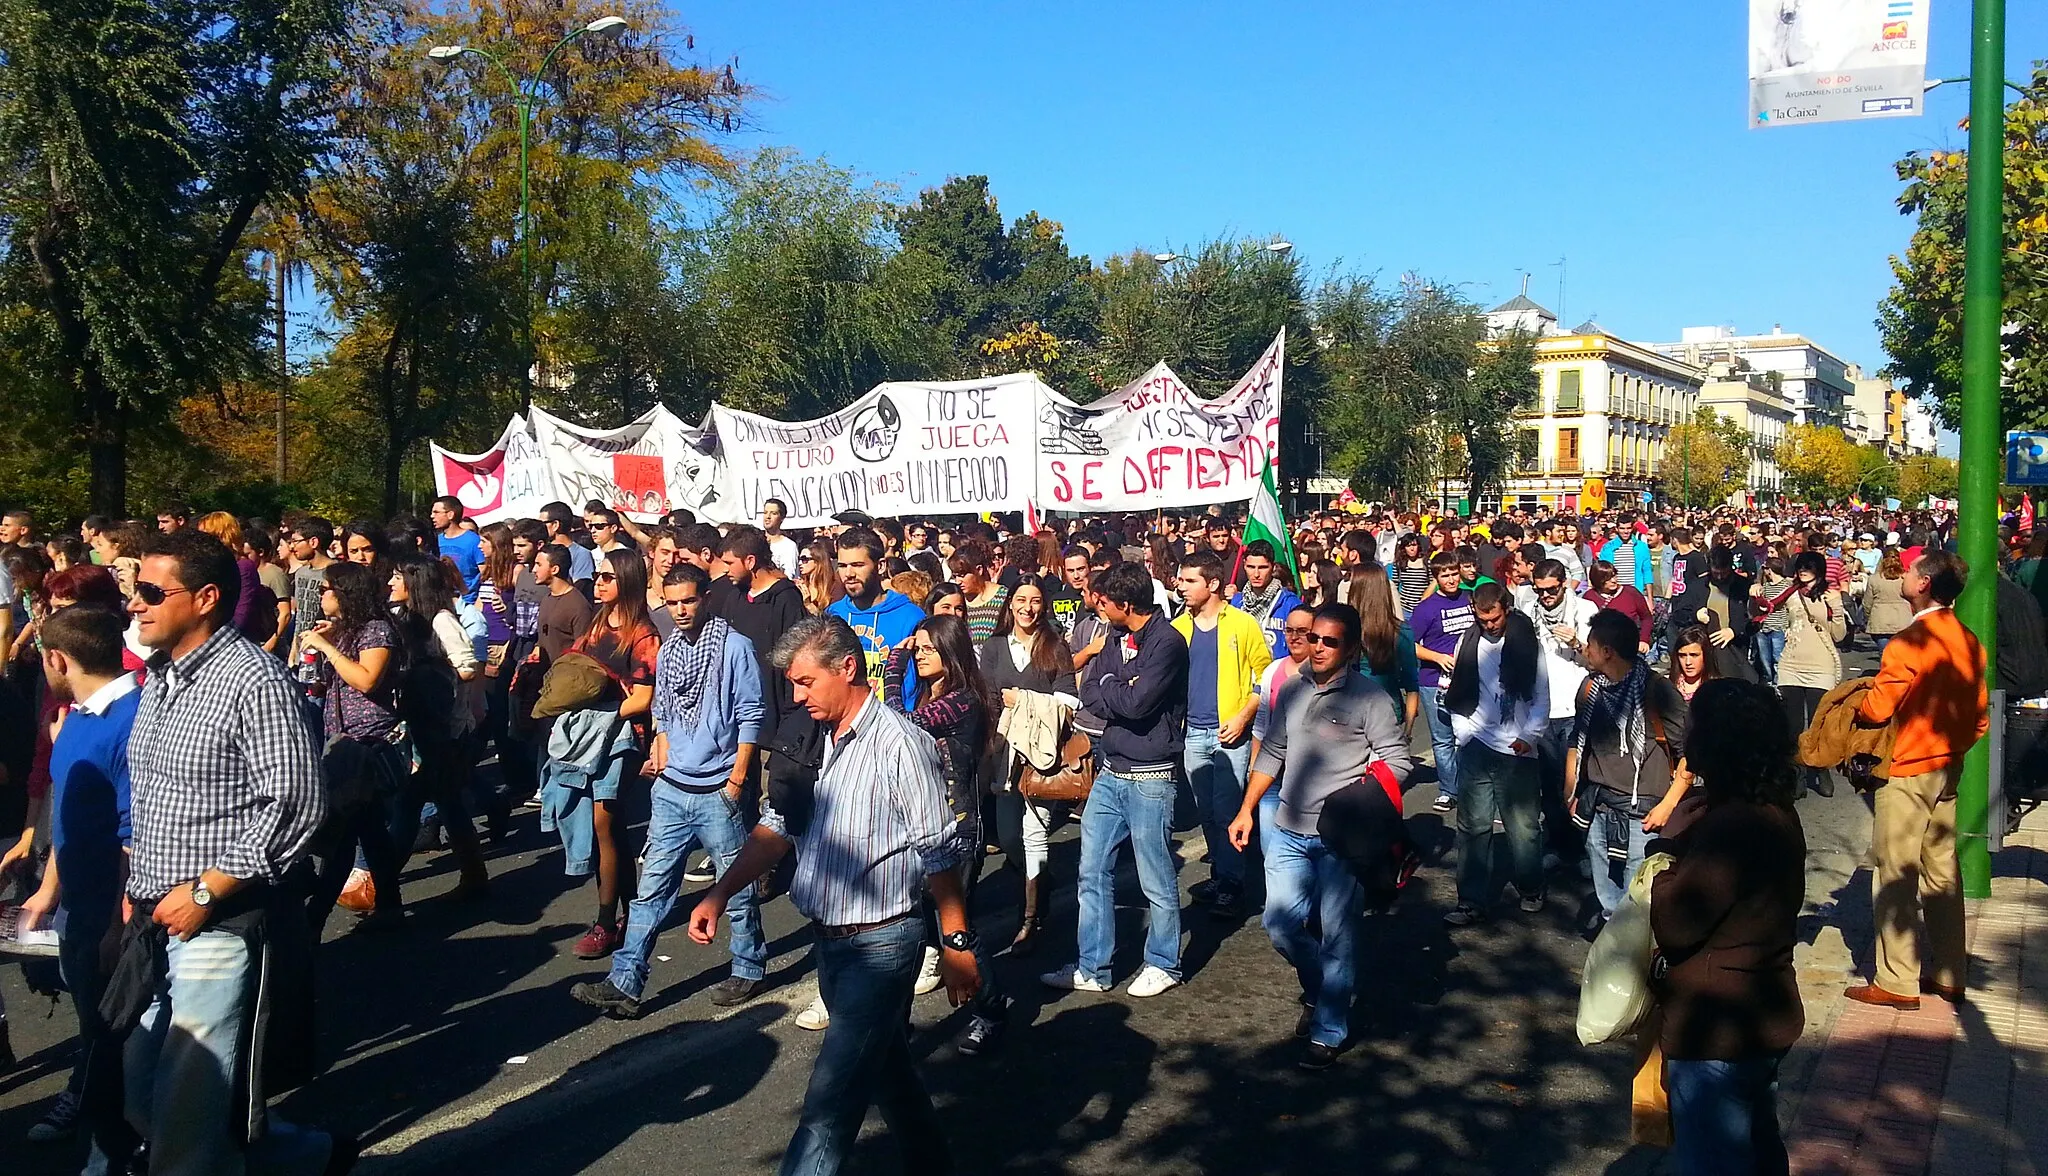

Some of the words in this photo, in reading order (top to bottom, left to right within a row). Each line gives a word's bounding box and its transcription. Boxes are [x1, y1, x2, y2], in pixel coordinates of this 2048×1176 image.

[1872, 40, 1917, 52] ANCCE
[927, 390, 956, 421] NO
[967, 386, 998, 420] SE
[921, 423, 1009, 450] JUEGA
[1167, 407, 1196, 438] SE
[752, 445, 834, 470] FUTURO
[869, 474, 889, 496] NO
[889, 471, 905, 493] ES
[935, 456, 1009, 503] NEGOCIO
[1051, 460, 1103, 503] SE
